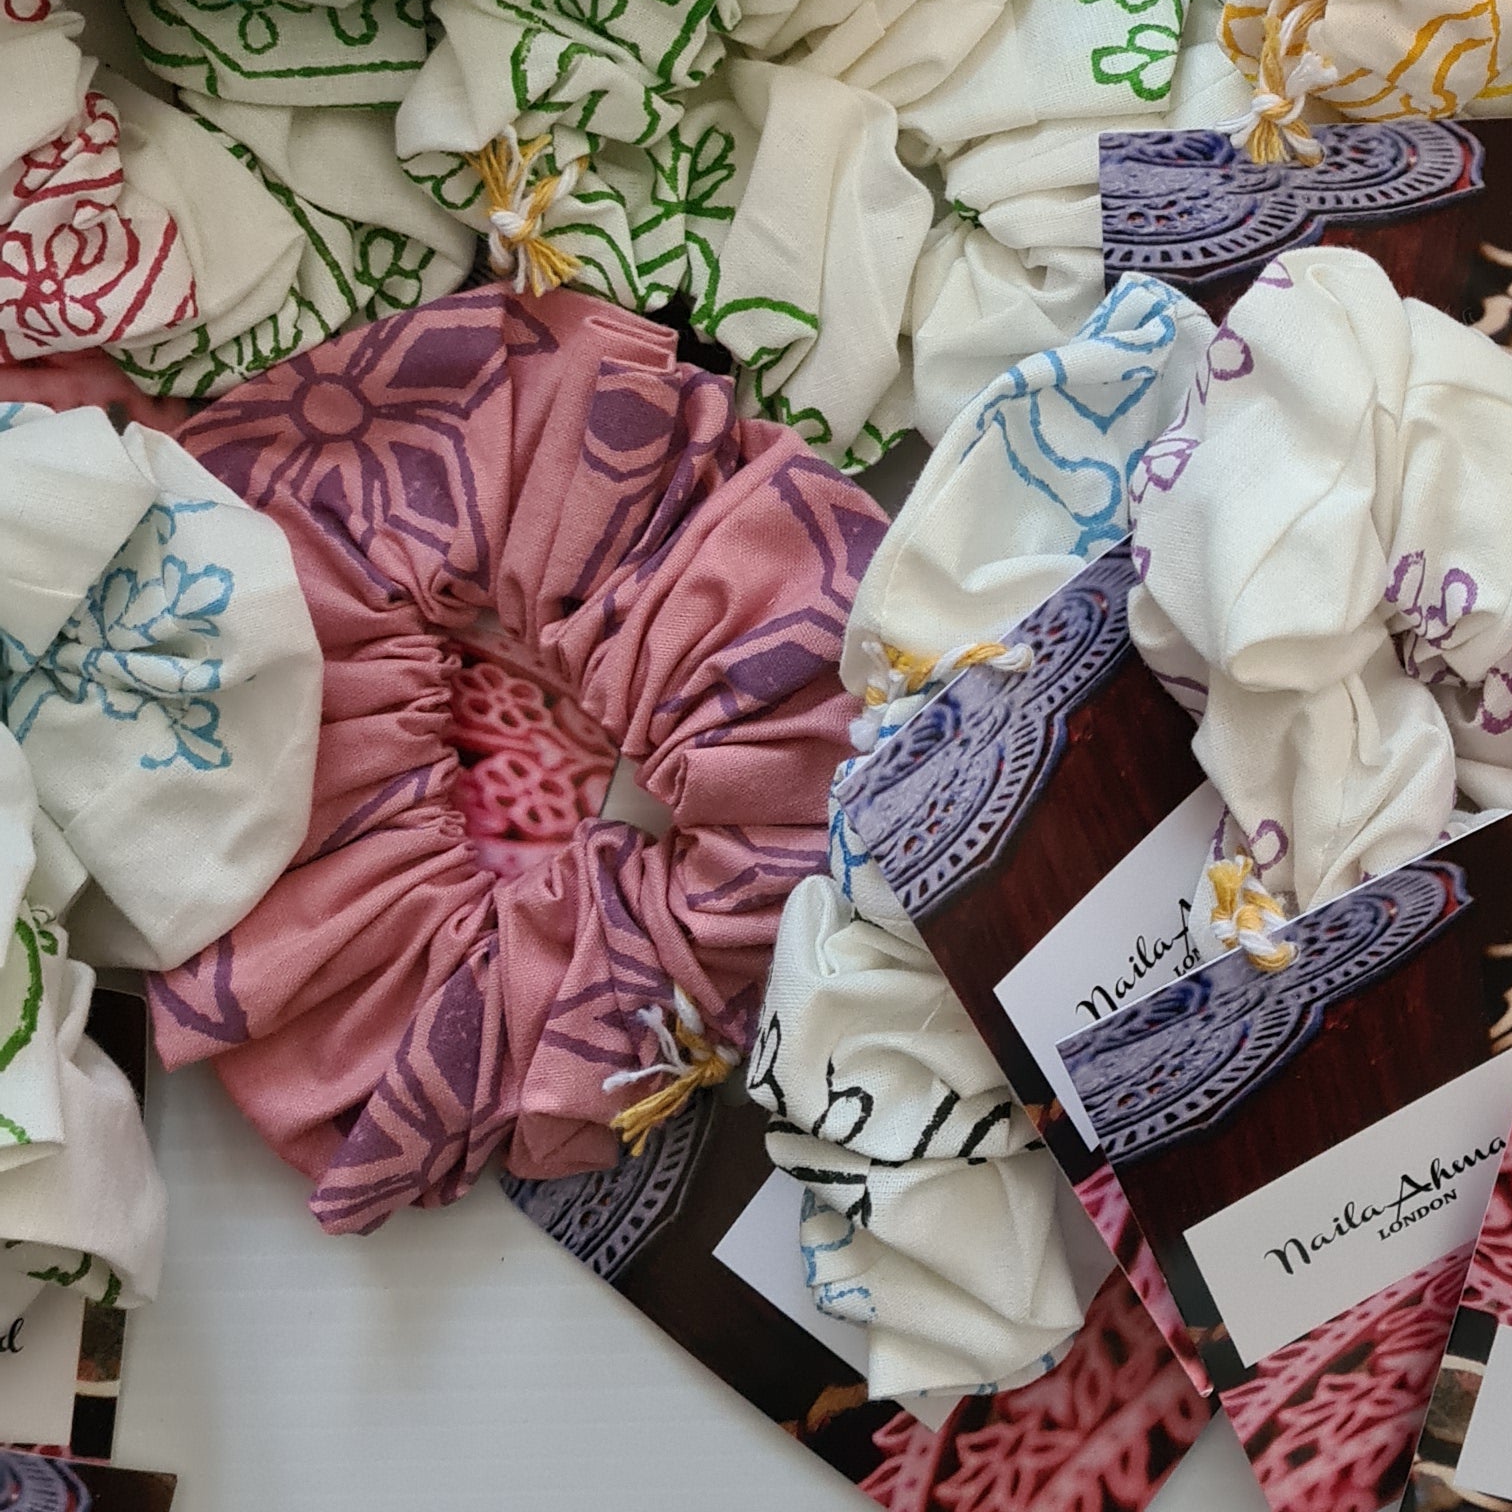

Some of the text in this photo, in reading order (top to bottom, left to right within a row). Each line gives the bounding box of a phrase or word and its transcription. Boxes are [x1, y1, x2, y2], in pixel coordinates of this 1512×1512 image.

[1263, 1136, 1507, 1275] Naila Ahma
[1377, 1189, 1459, 1241] LONDON
